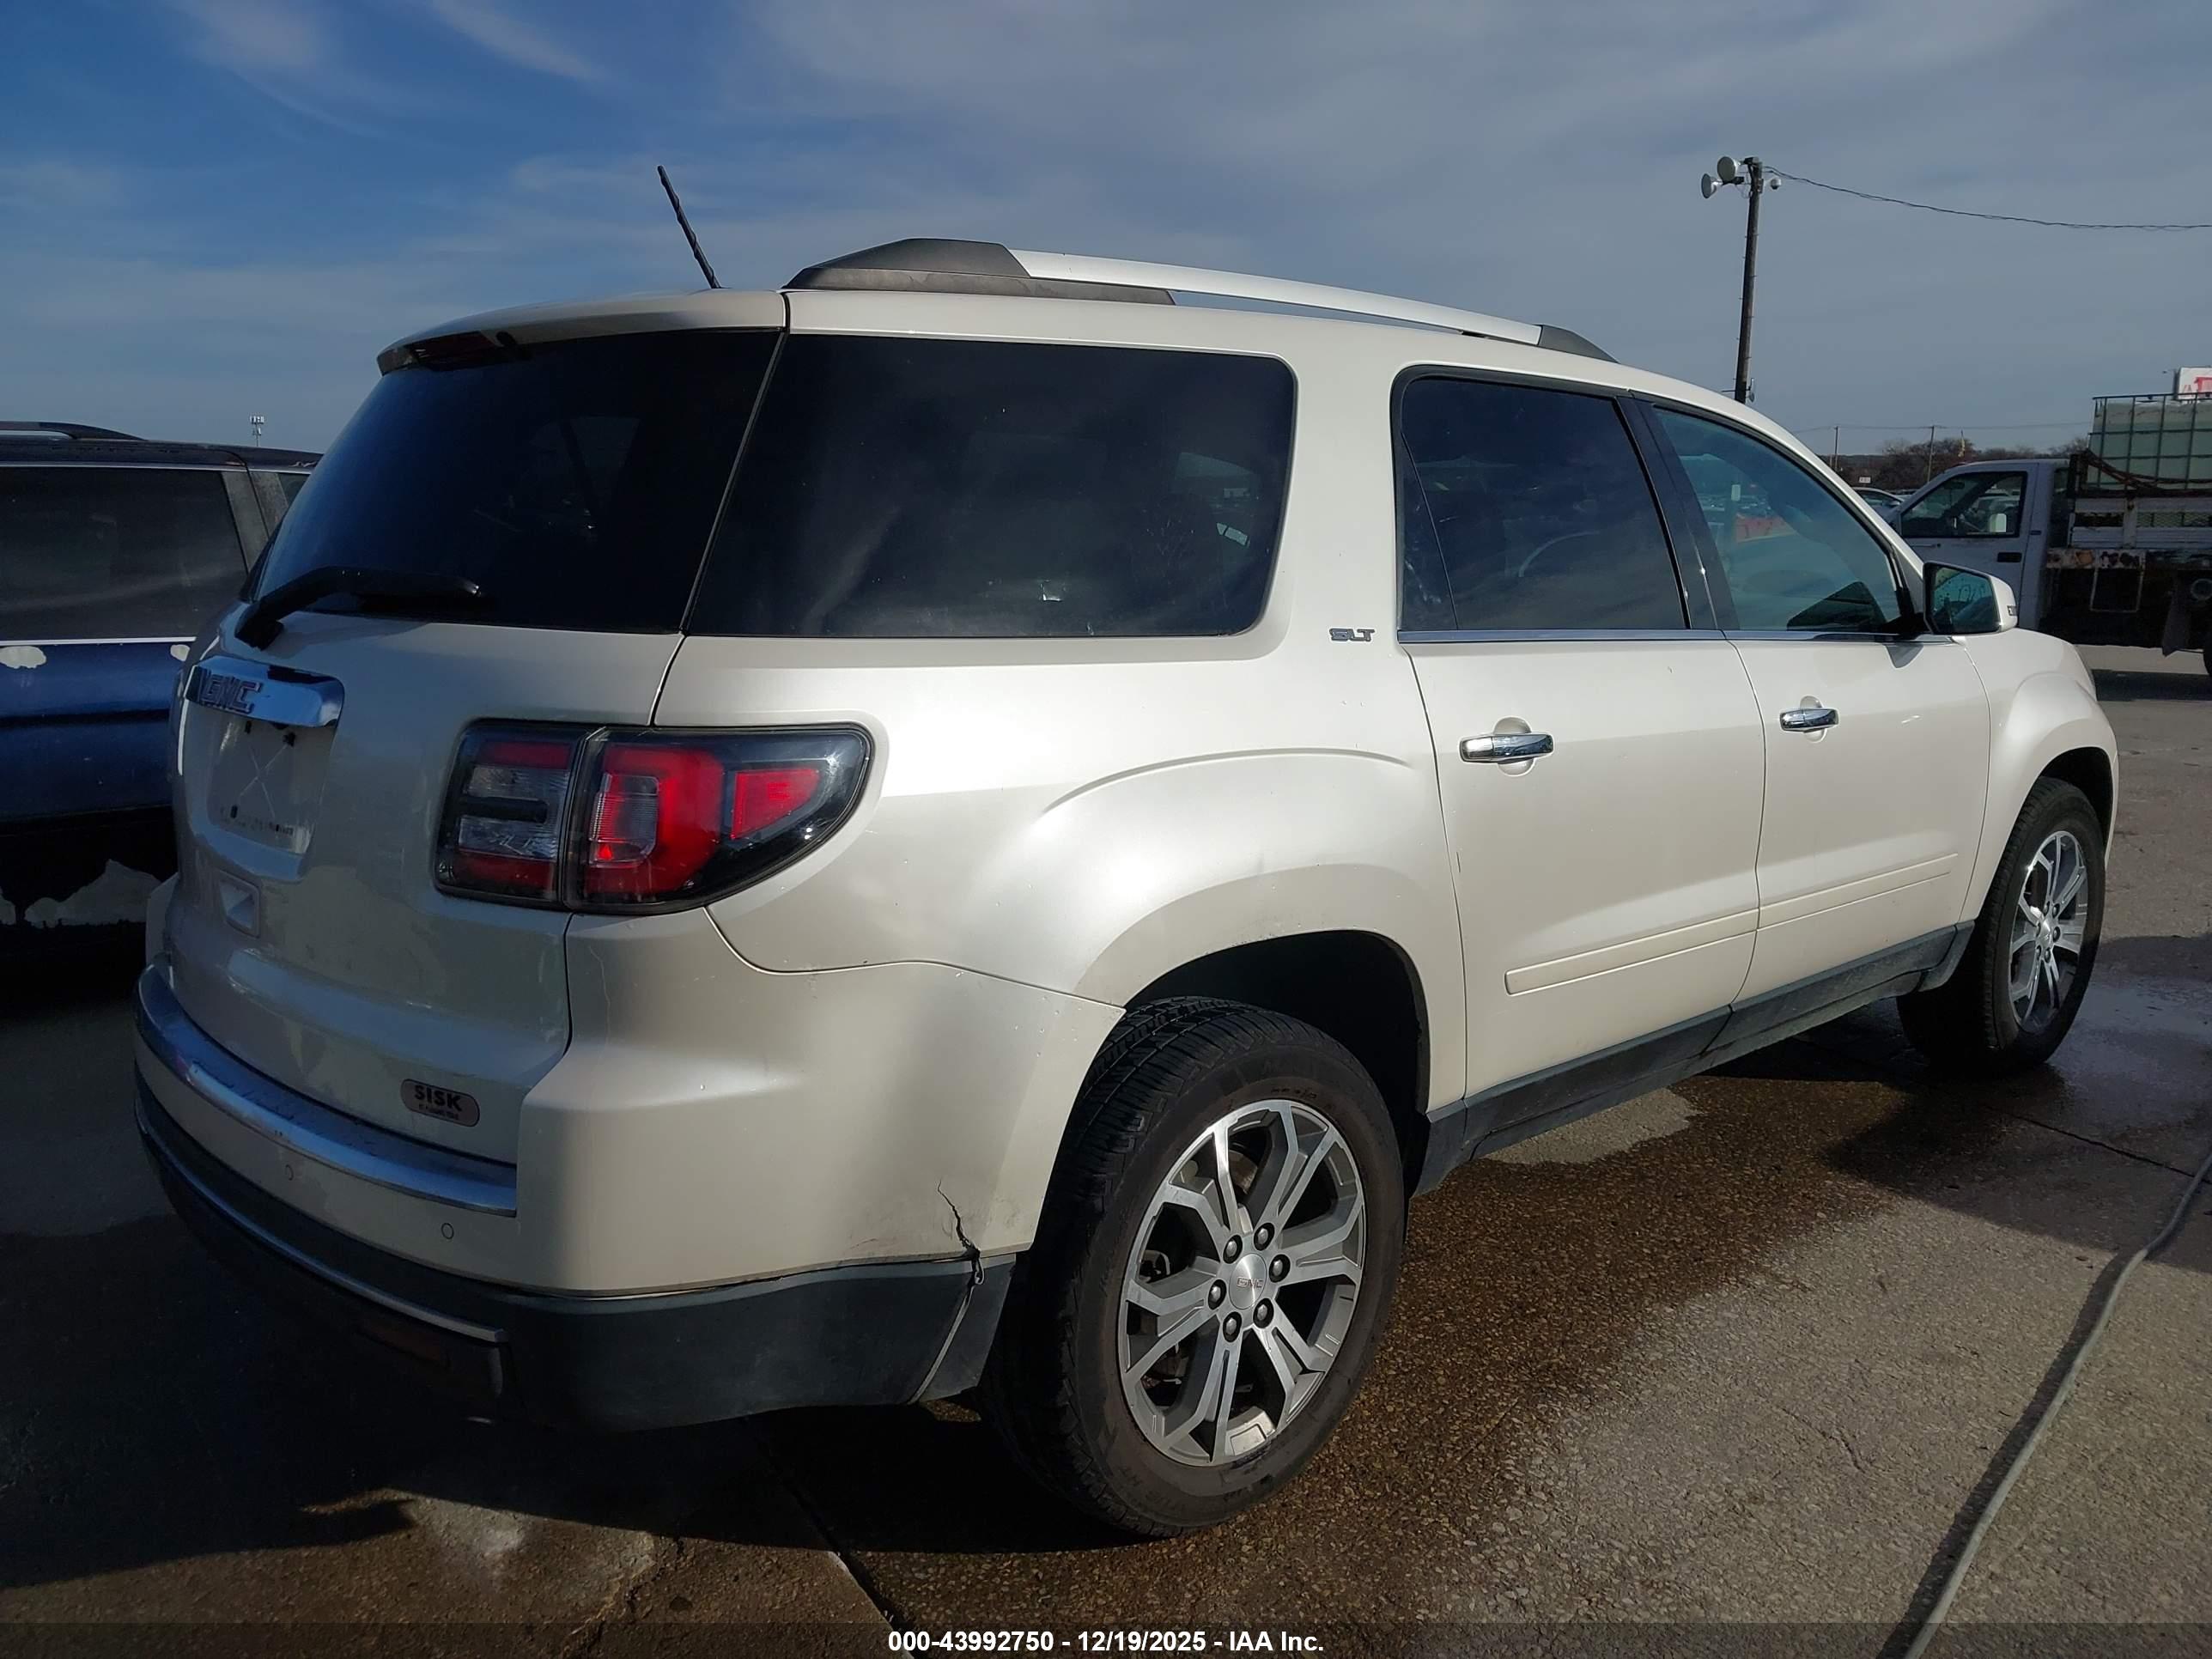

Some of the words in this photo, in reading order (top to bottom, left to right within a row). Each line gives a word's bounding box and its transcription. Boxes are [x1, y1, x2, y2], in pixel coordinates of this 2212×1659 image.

[1328, 628, 1376, 642] SLT
[200, 673, 262, 714] GMC
[414, 1085, 463, 1112] SISK
[1237, 1276, 1264, 1290] GMC
